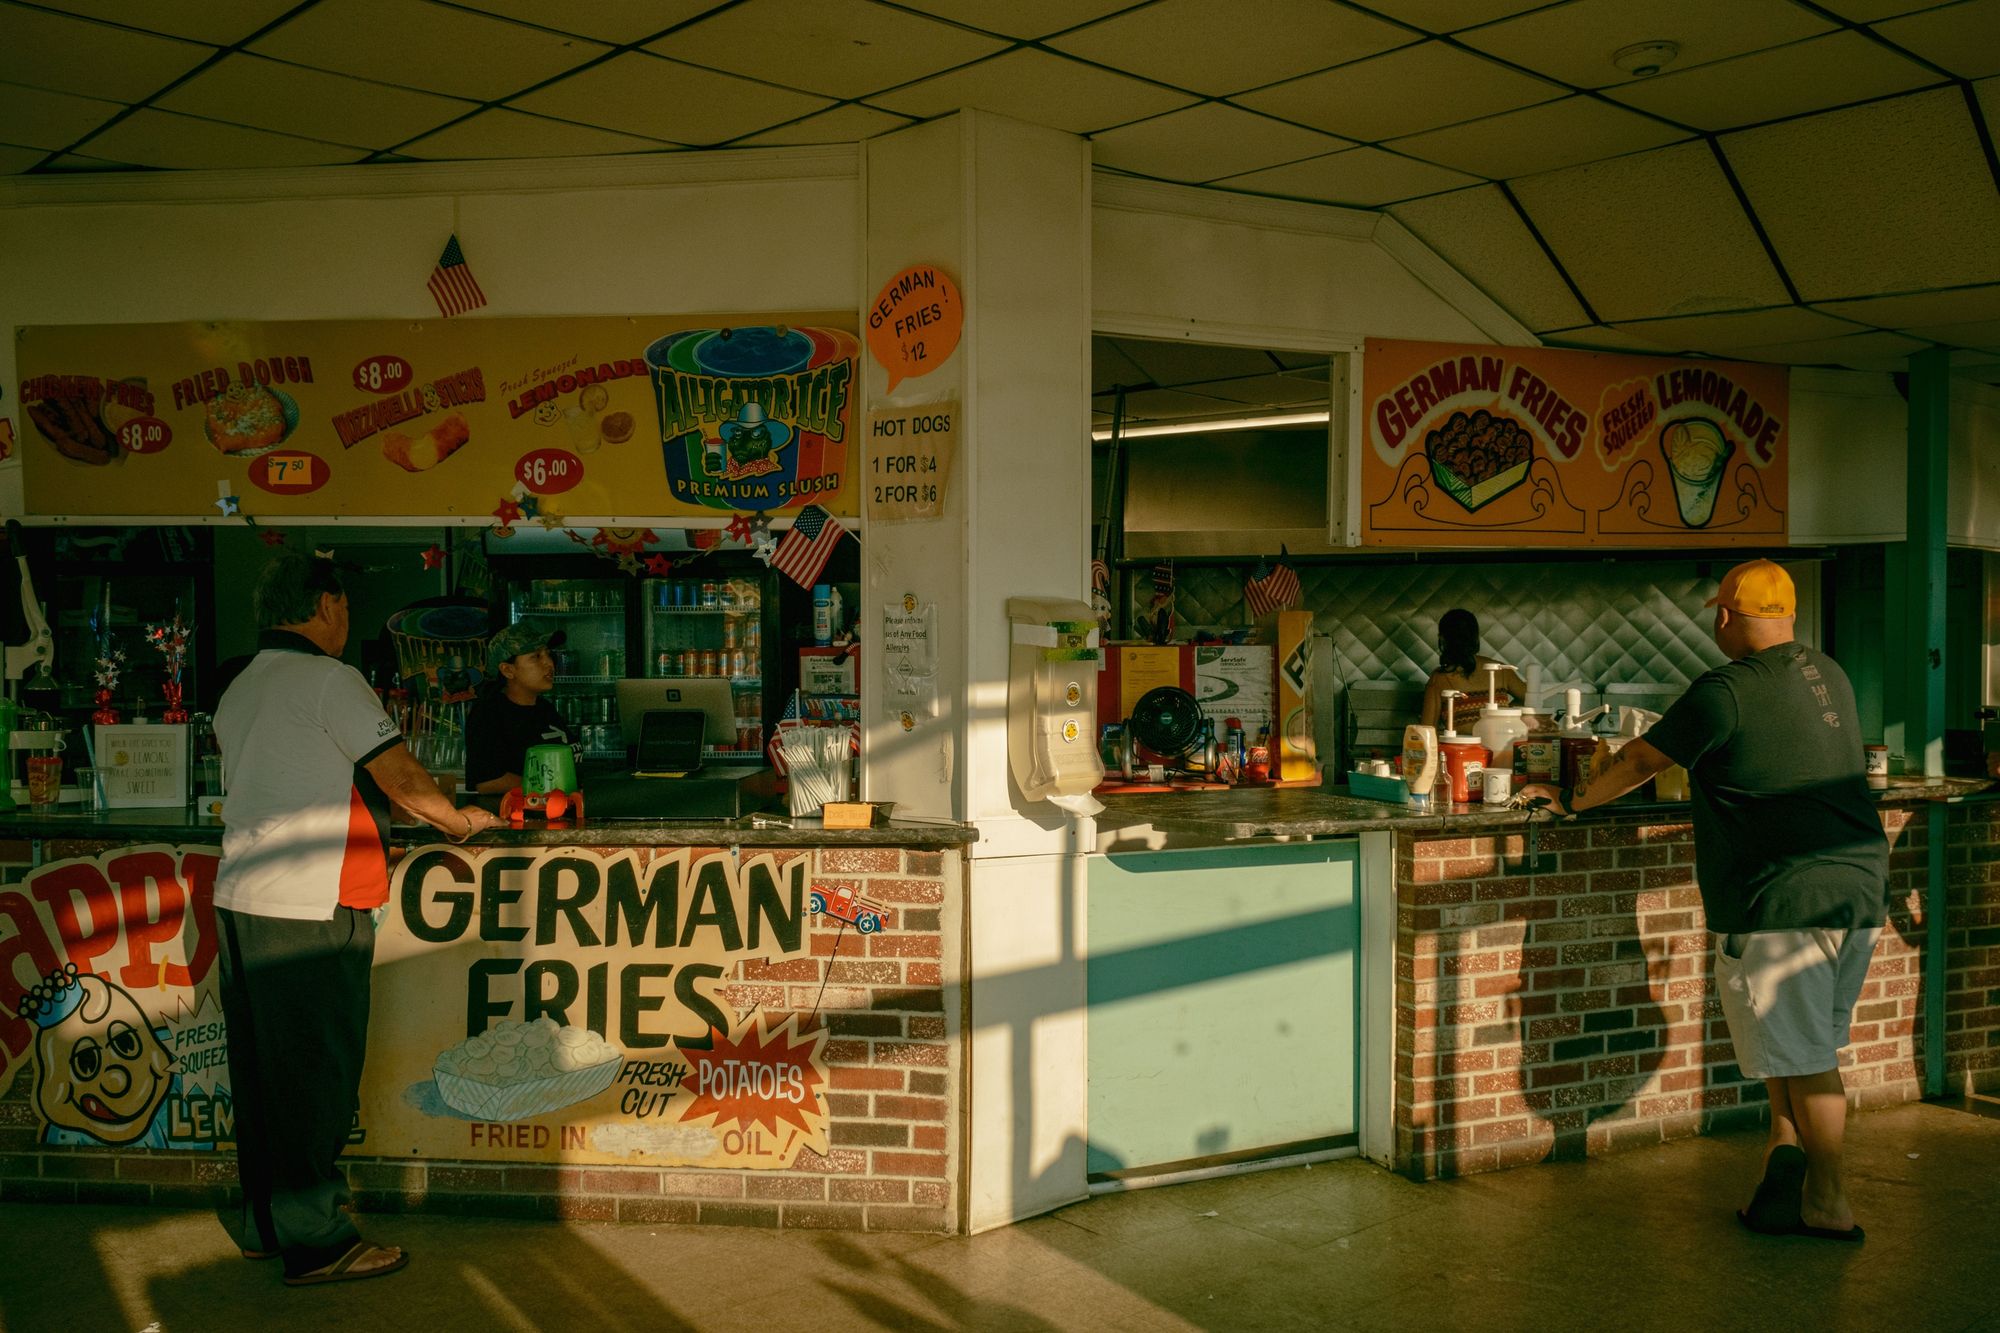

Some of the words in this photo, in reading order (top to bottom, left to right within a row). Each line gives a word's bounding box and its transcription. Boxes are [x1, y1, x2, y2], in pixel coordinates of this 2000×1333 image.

[869, 270, 936, 330] GERMAN
[894, 302, 943, 339] FRIES
[901, 341, 928, 363] $12
[171, 367, 230, 411] FRIED
[238, 356, 314, 389] DOUGH
[358, 361, 403, 390] $8.00
[507, 358, 650, 420] LEMONADE
[20, 374, 105, 404] CHICKEN
[106, 379, 156, 417] FRIES
[1376, 356, 1504, 449] GERMAN
[1508, 365, 1588, 459] FRIES
[1602, 388, 1647, 432] FRESH
[331, 386, 431, 450] MOZZARELL
[873, 418, 906, 437] HOT
[912, 415, 951, 435] DOGS
[1602, 401, 1656, 456] SQUEEZED
[1656, 368, 1781, 463] LEMONADE
[121, 423, 163, 451] $8.00
[522, 457, 568, 486] $6.00
[872, 456, 880, 473] 1
[886, 456, 917, 474] FOR
[920, 455, 937, 474] $4
[676, 479, 770, 499] PREMIUM
[777, 474, 839, 497] SLUSH
[874, 486, 882, 503] 2
[885, 485, 918, 503] FOR
[921, 483, 937, 503] $6
[913, 629, 927, 639] Food
[528, 755, 554, 782] TIPS
[401, 849, 804, 954] GERMAN
[467, 957, 729, 1051] FRIES
[180, 1045, 227, 1075] SQUEEZ
[617, 1060, 688, 1085] FRESH
[699, 1059, 804, 1104] POTATOES
[620, 1089, 675, 1118] CUT
[470, 1123, 551, 1149] FRIED
[560, 1126, 586, 1150] IN
